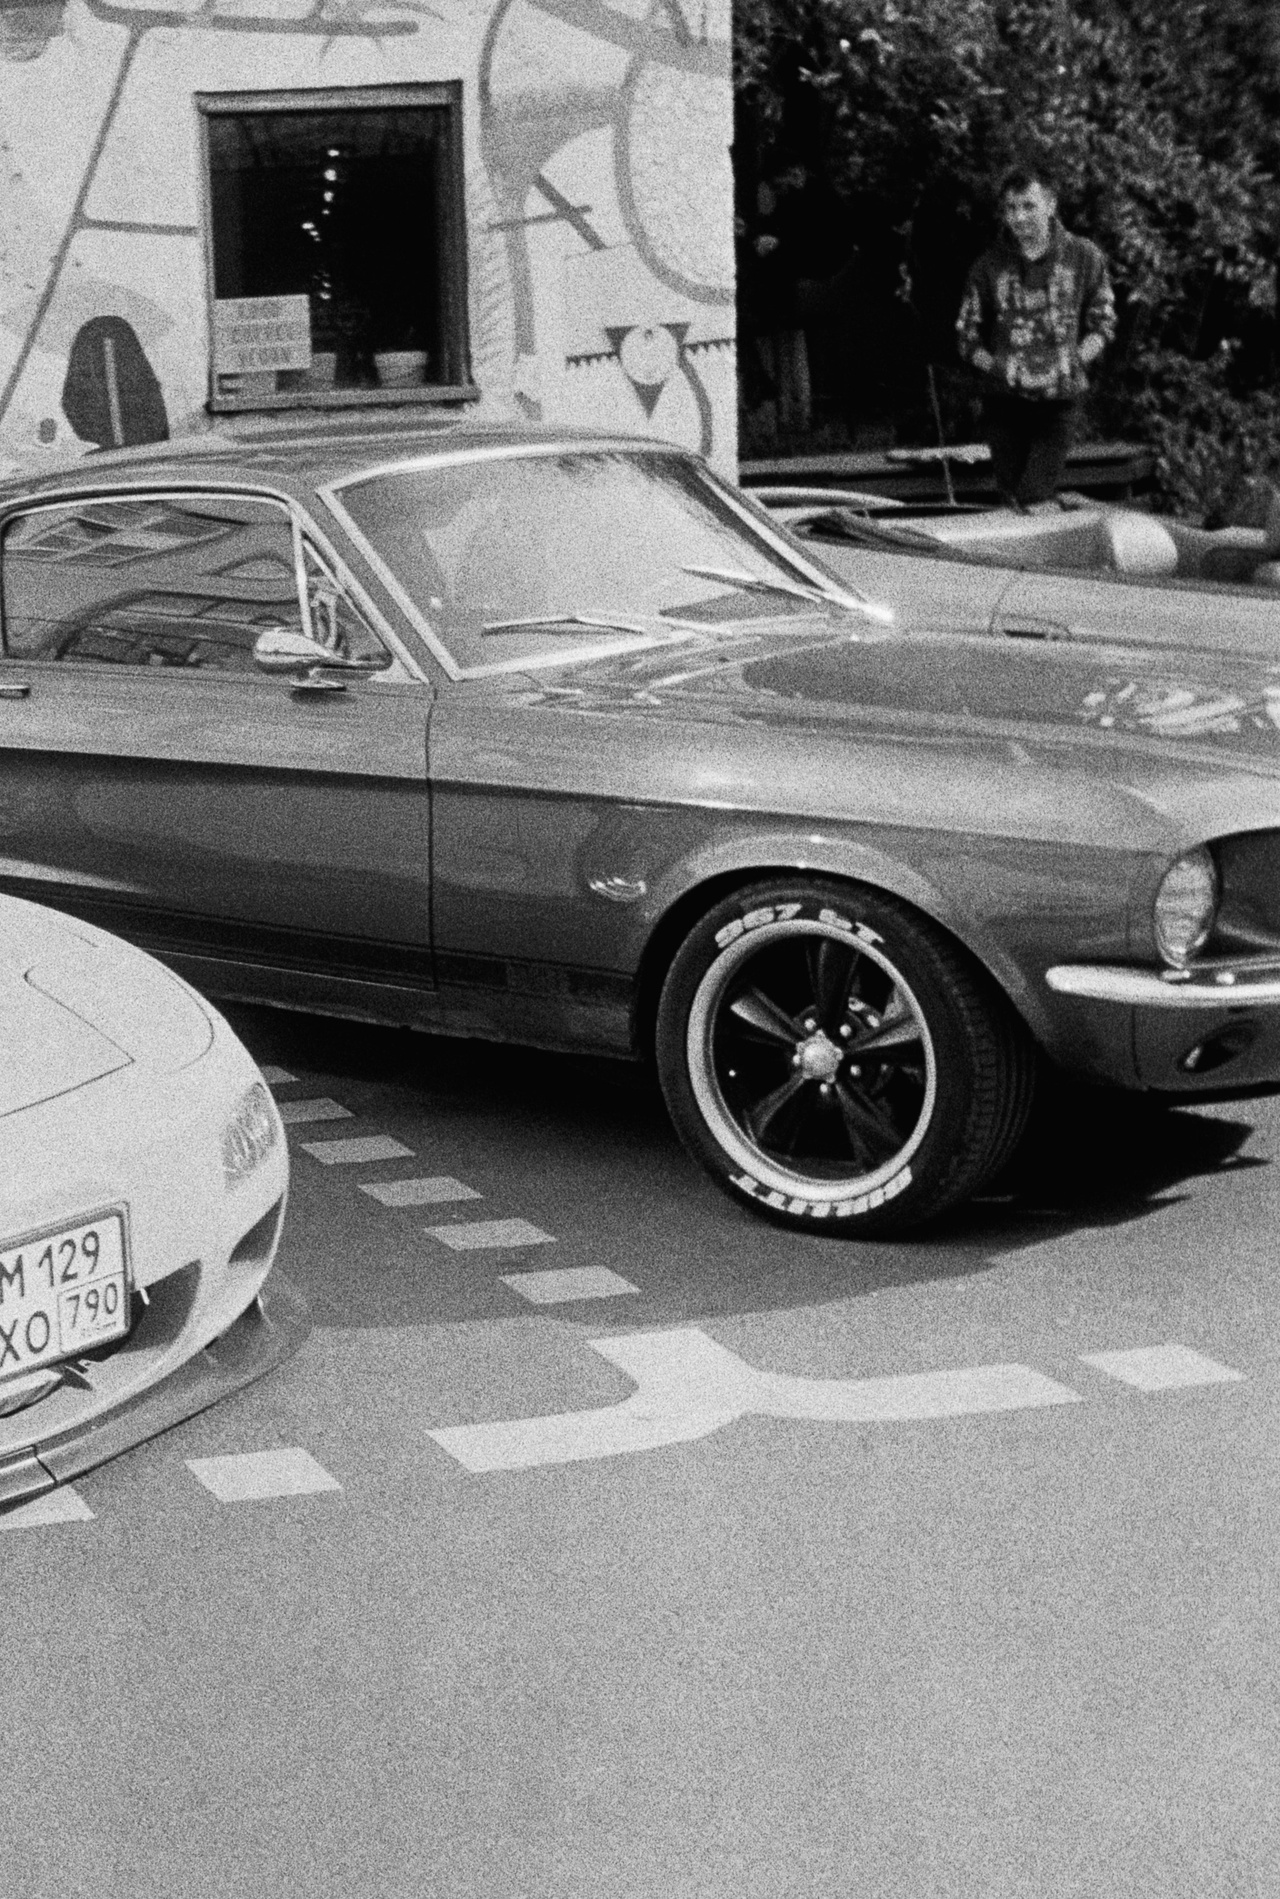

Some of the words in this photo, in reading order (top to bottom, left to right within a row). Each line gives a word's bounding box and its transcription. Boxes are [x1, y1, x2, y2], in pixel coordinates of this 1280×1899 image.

[728, 1164, 913, 1218] BULLITT
[37, 1230, 100, 1288] 129
[65, 1282, 118, 1329] 790
